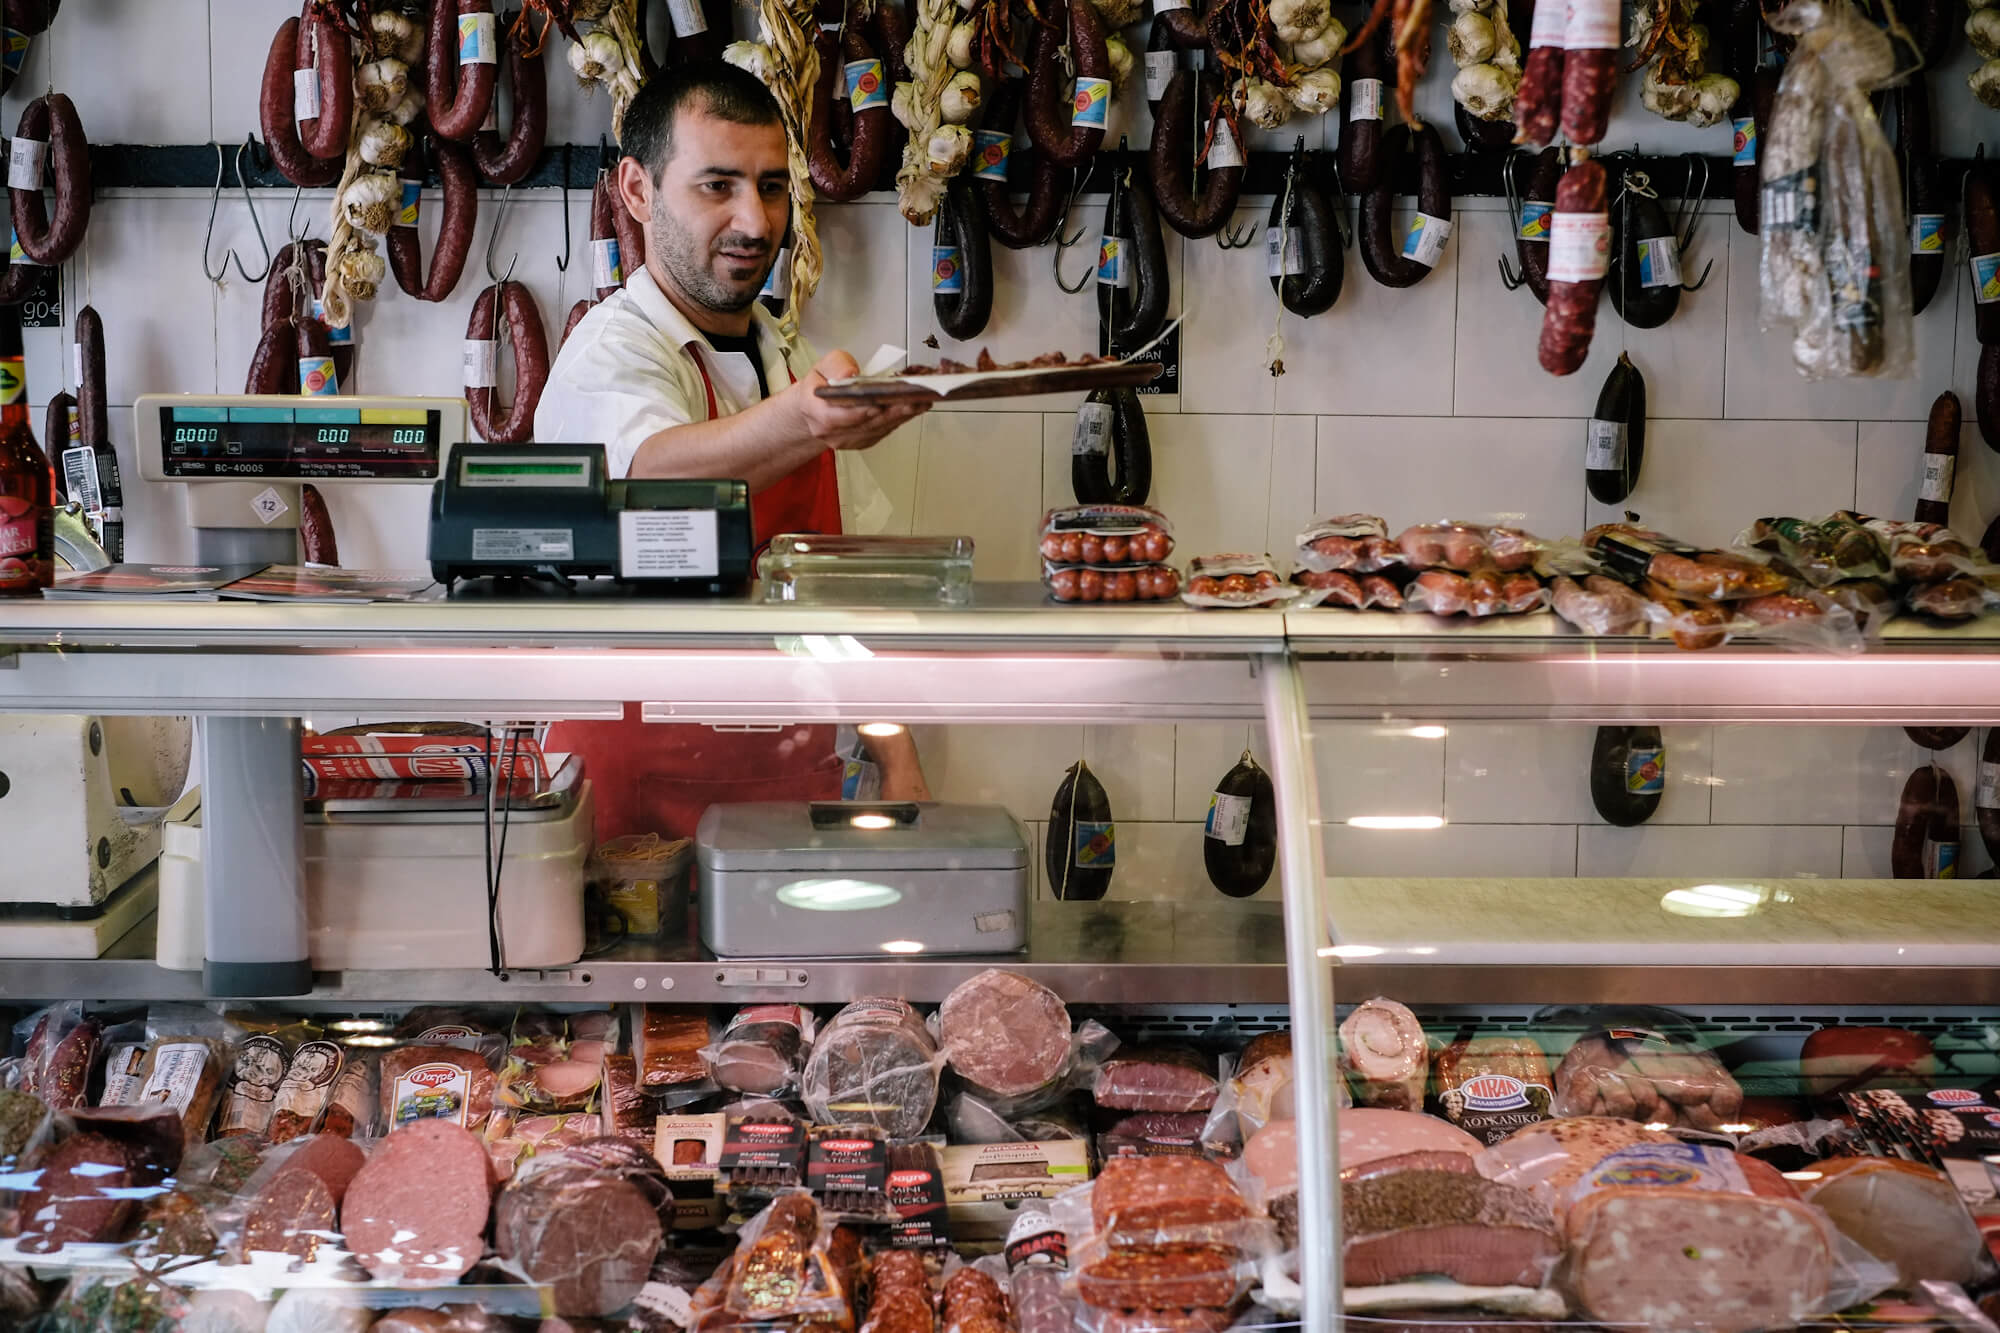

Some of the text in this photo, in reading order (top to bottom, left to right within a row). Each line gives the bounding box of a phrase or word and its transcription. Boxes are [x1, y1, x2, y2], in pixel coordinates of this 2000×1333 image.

[317, 428, 349, 443] 0.00
[392, 429, 425, 444] 0.00
[214, 463, 264, 473] BC-4000S
[263, 500, 276, 511] 12
[1469, 1079, 1518, 1098] MIRAN
